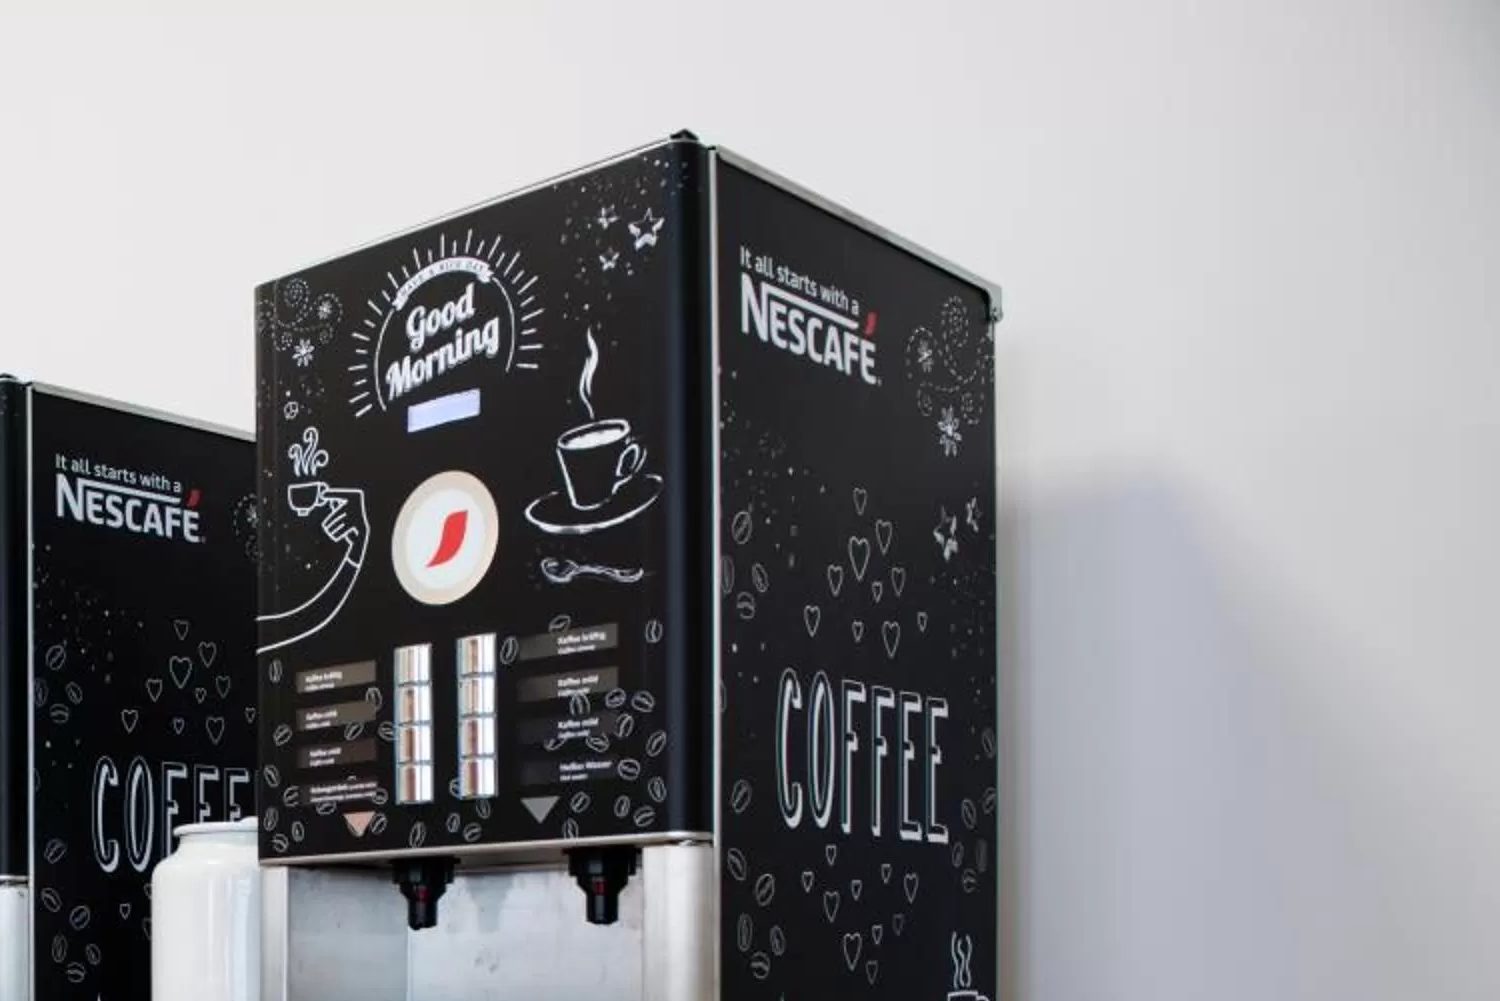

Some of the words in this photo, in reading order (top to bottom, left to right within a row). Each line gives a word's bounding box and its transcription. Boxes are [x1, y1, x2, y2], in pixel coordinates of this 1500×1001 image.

[406, 282, 476, 353] Good
[740, 245, 752, 269] It
[755, 255, 774, 279] all
[777, 265, 818, 297] starts
[820, 284, 849, 312] with
[851, 300, 860, 316] a
[386, 316, 500, 401] Morning
[55, 453, 67, 471] It
[71, 458, 91, 475] all
[94, 464, 137, 484] starts
[139, 472, 171, 490] with
[173, 481, 182, 493] a
[776, 667, 949, 845] COFFEE
[92, 756, 258, 873] COFF
